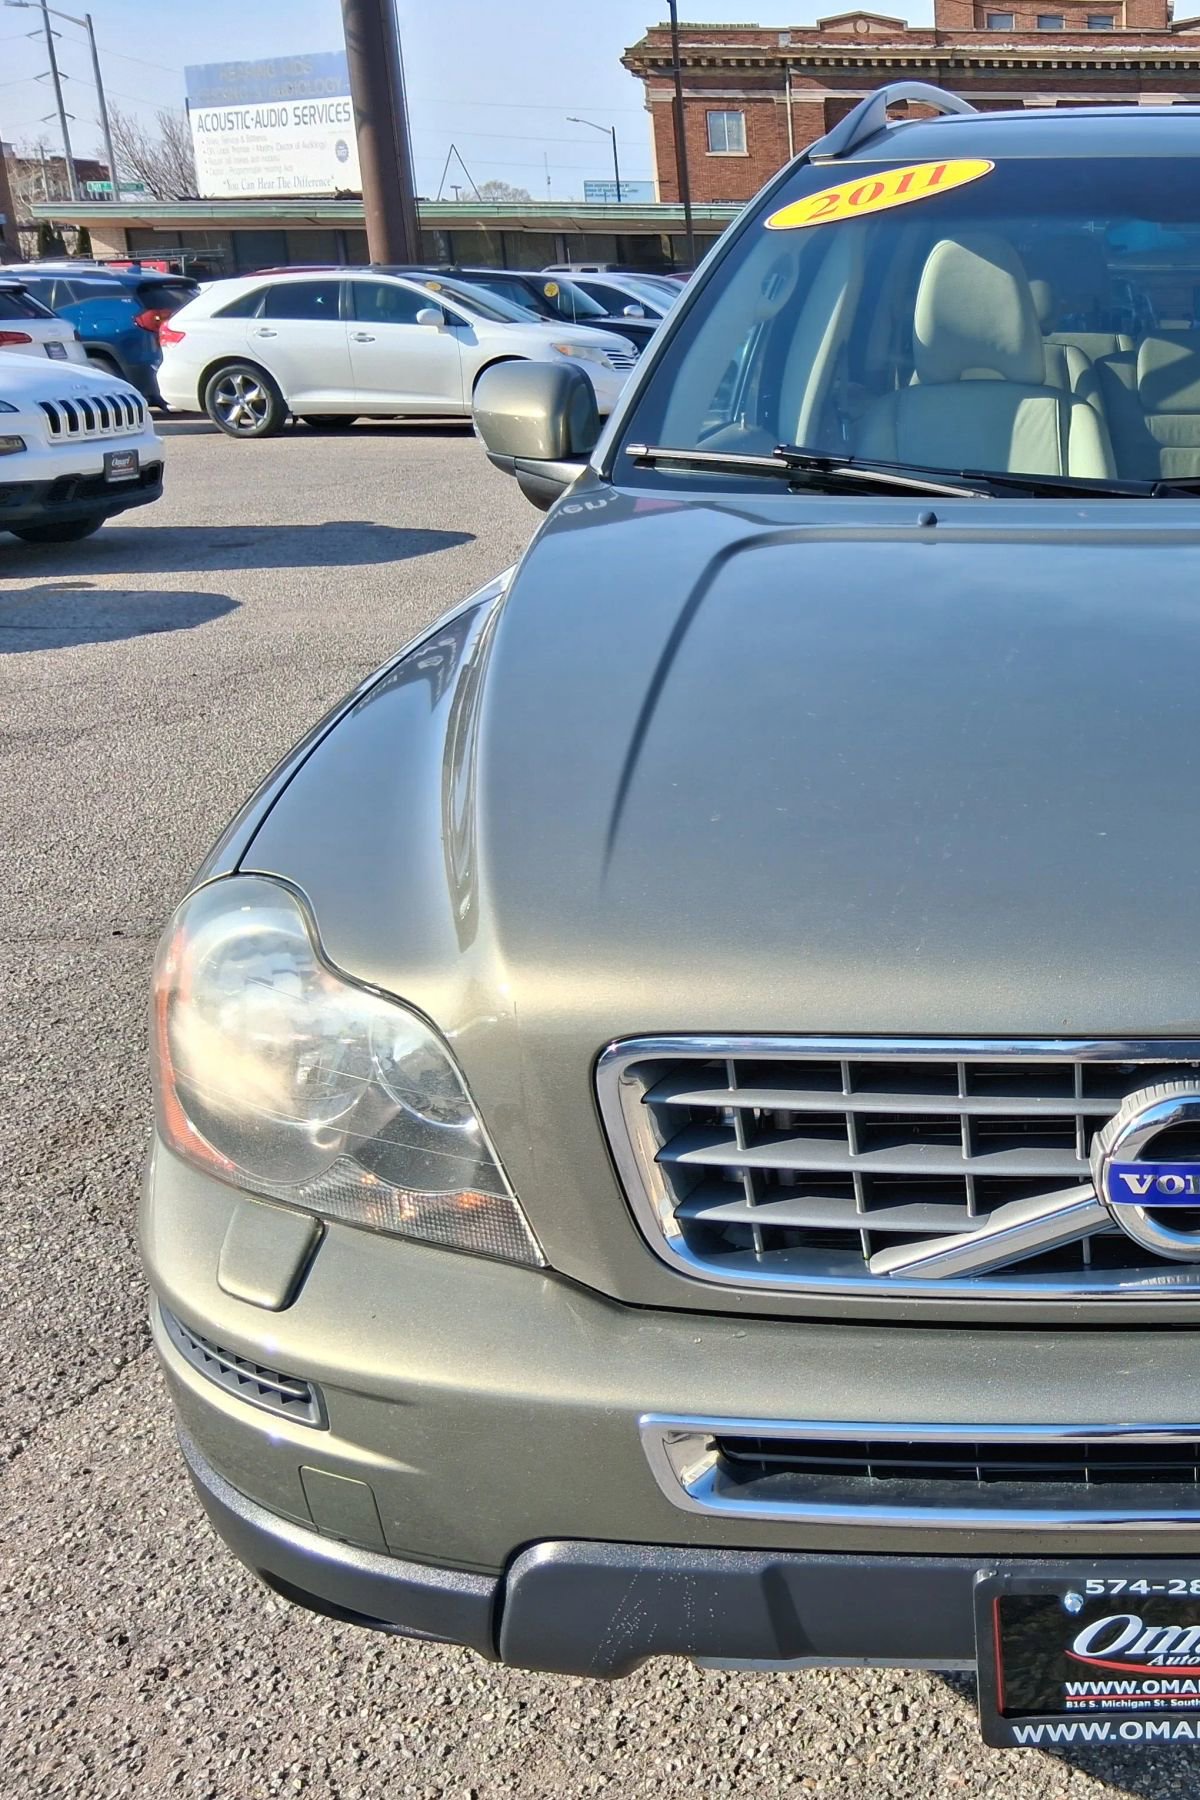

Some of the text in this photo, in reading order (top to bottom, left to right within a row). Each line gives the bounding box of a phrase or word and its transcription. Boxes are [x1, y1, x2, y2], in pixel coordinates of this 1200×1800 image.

[292, 102, 351, 127] SERVICES
[241, 177, 255, 191] Can
[257, 176, 275, 190] Hear
[277, 175, 292, 189] The
[805, 164, 948, 222] 2011
[1101, 1699, 1151, 1710] Michigan
[1153, 1699, 1168, 1708] St.
